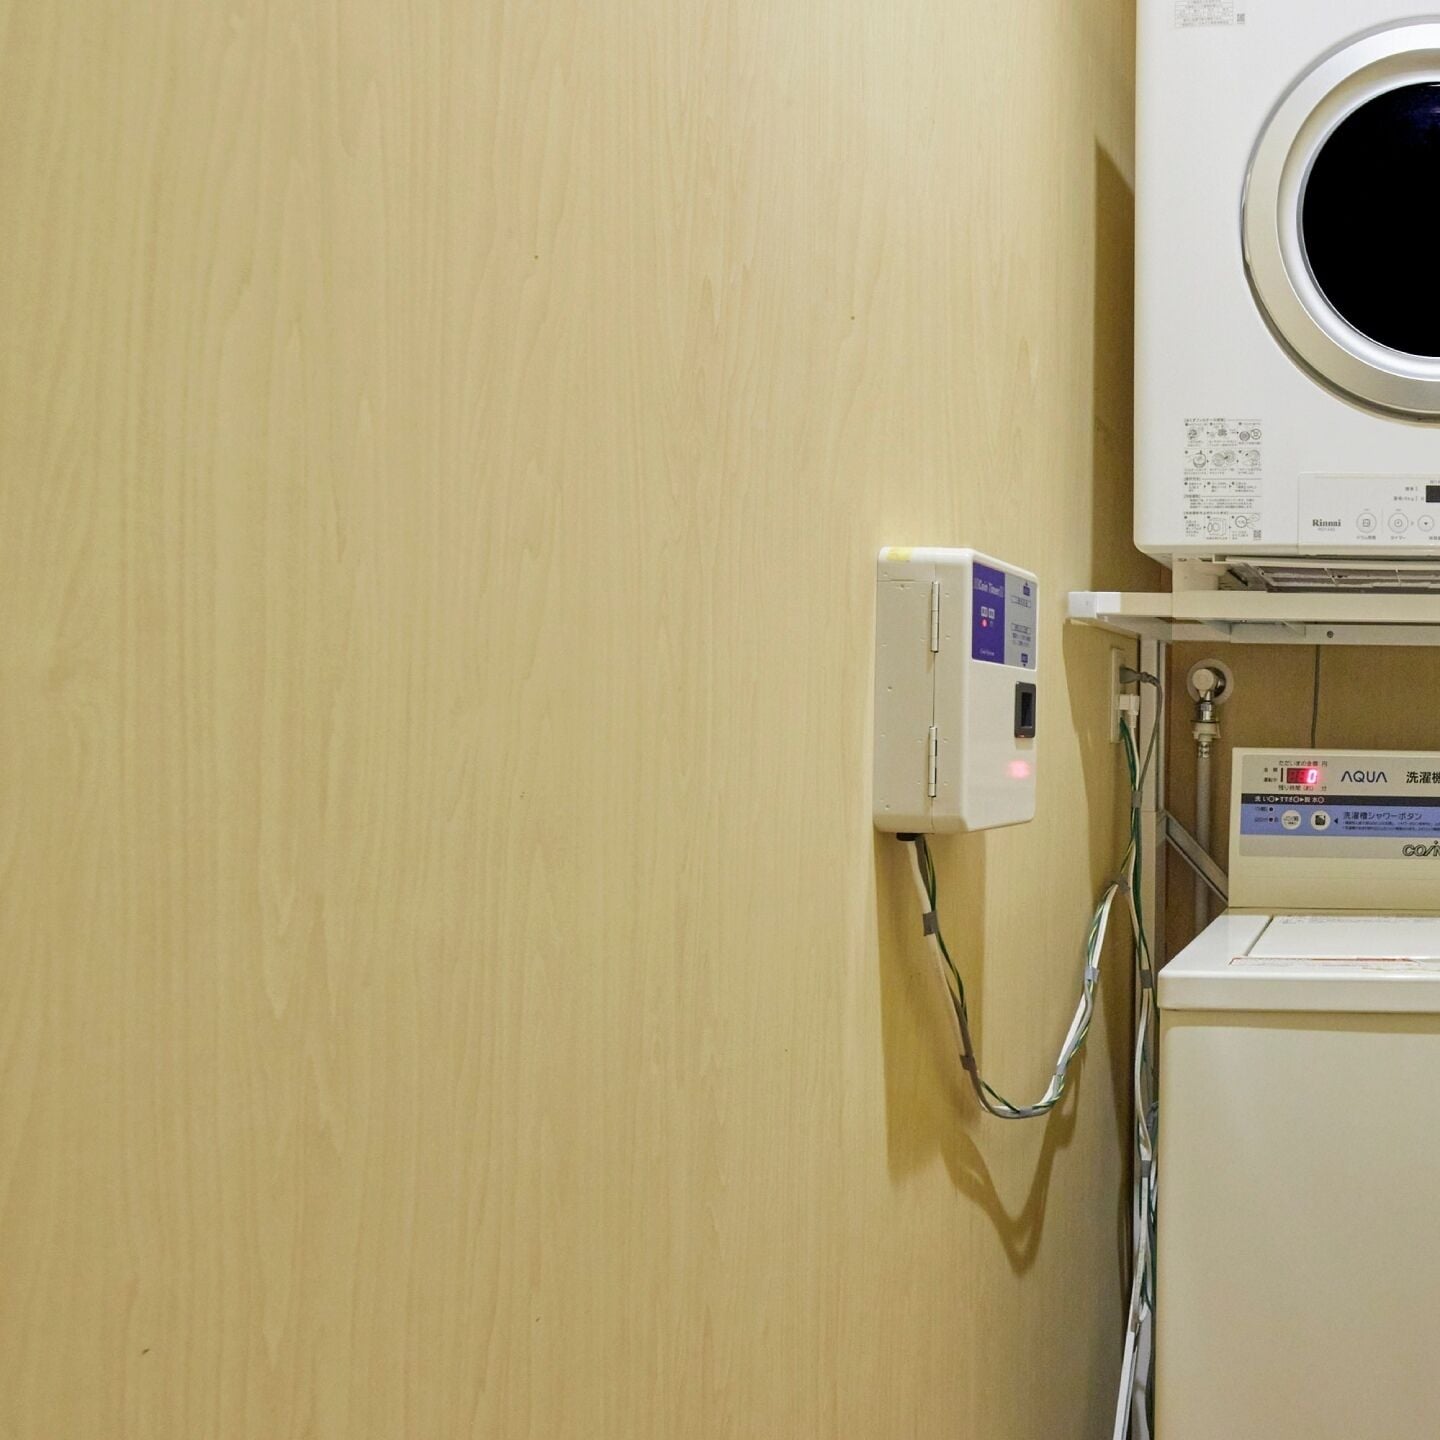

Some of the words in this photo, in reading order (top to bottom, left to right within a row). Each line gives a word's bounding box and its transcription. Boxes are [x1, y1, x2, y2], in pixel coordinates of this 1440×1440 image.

[1312, 519, 1341, 527] Rinnai
[1341, 771, 1388, 783] AQUA
[1343, 811, 1422, 821] 洗濯槽シャワーボタン
